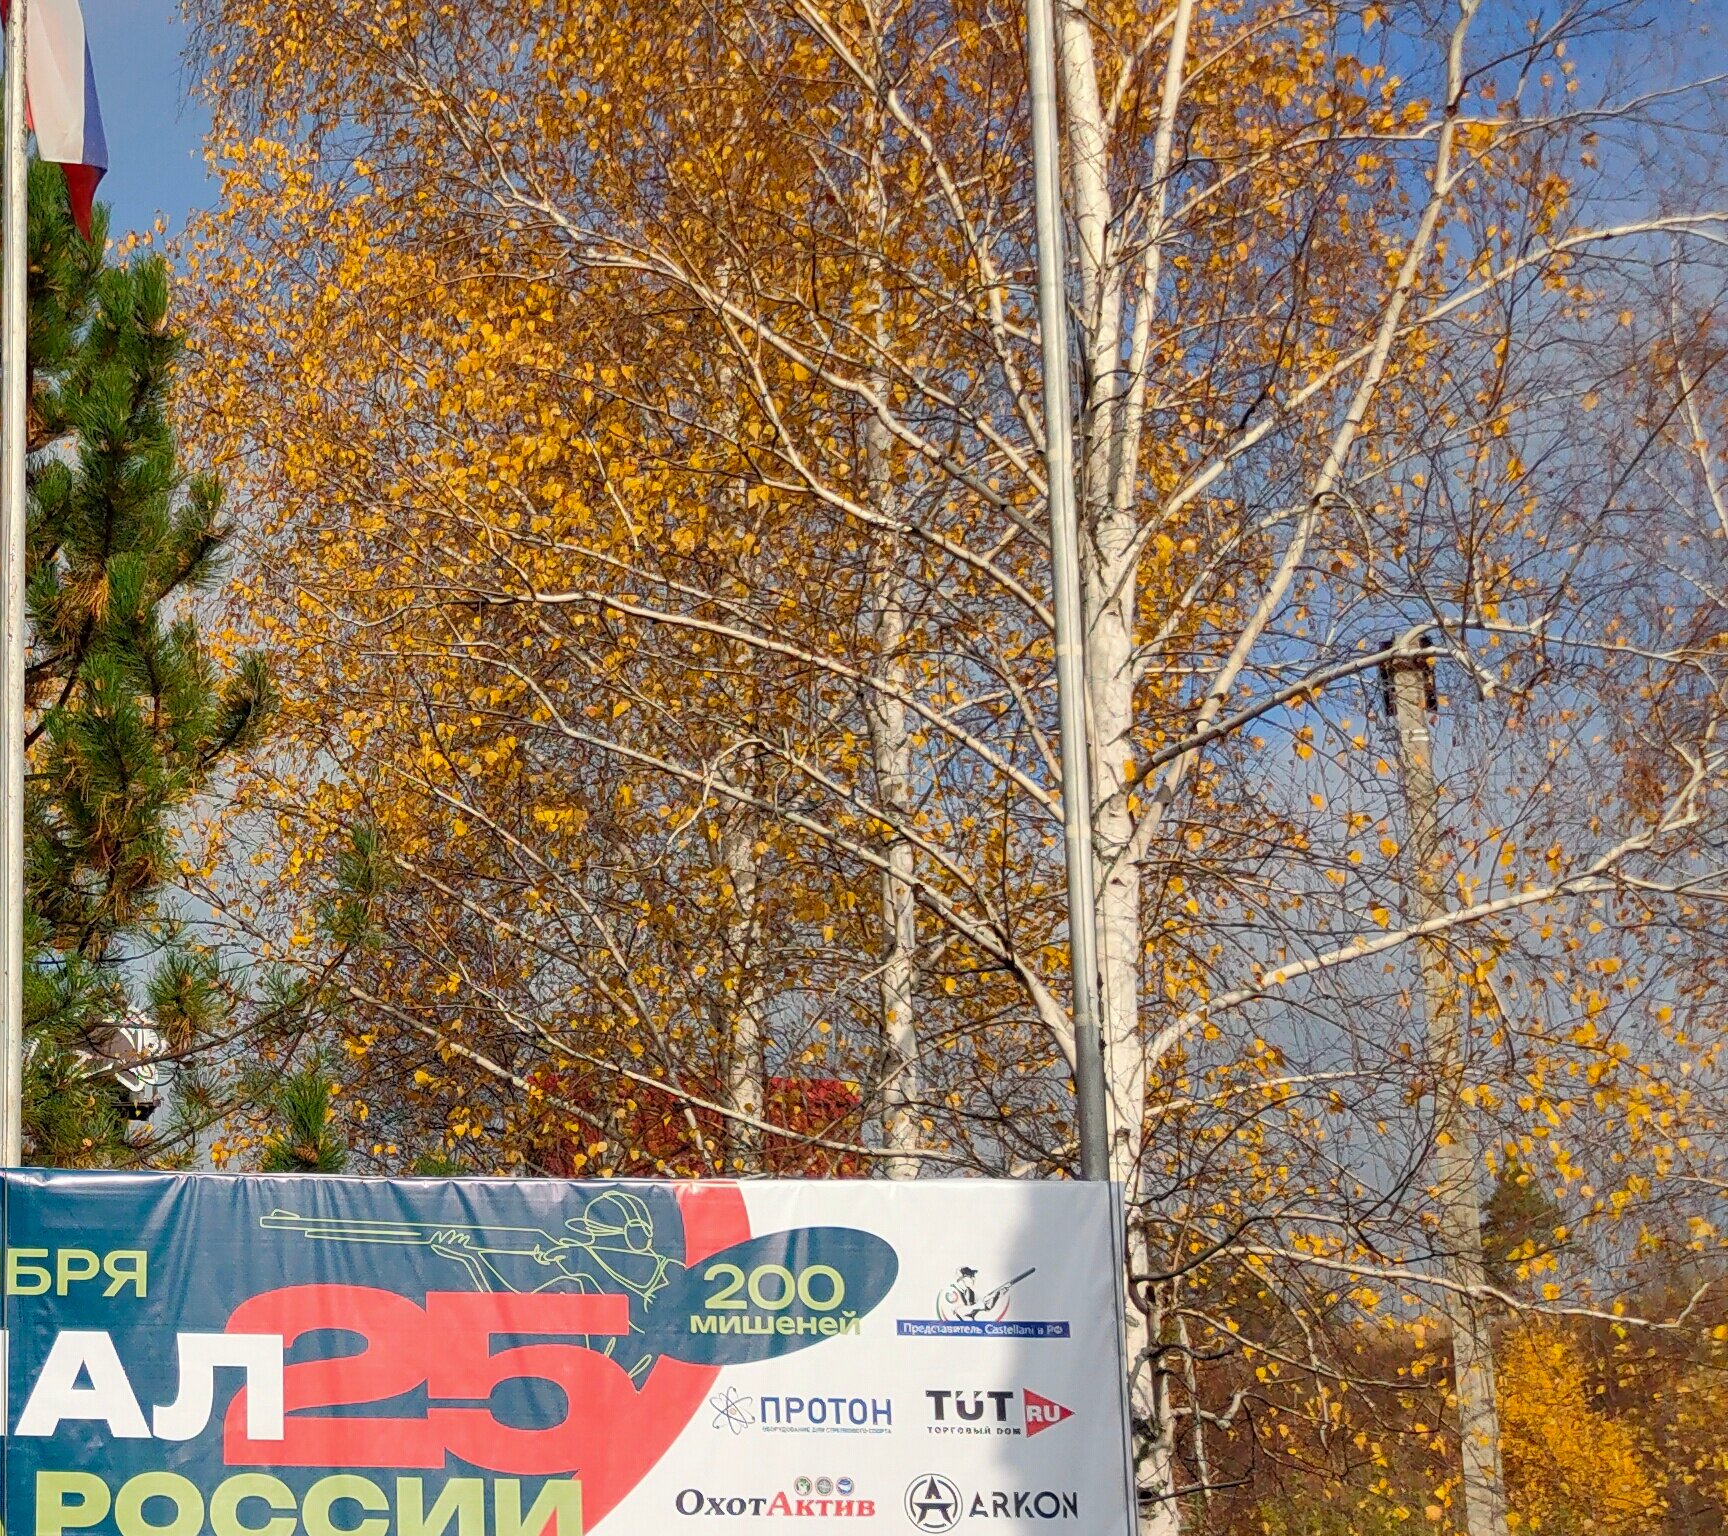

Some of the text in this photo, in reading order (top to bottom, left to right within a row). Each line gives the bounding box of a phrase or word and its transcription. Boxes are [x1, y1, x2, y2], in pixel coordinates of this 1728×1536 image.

[703, 1263, 846, 1312] 200
[690, 1310, 861, 1335] мишеней
[902, 1322, 983, 1335] Представитель
[224, 1283, 636, 1476] 25
[760, 1396, 892, 1425] ПРОТОН
[1026, 1404, 1060, 1422] RU
[927, 1425, 991, 1435] ТОРГОВЫЙ
[969, 1491, 1078, 1519] ARKON
